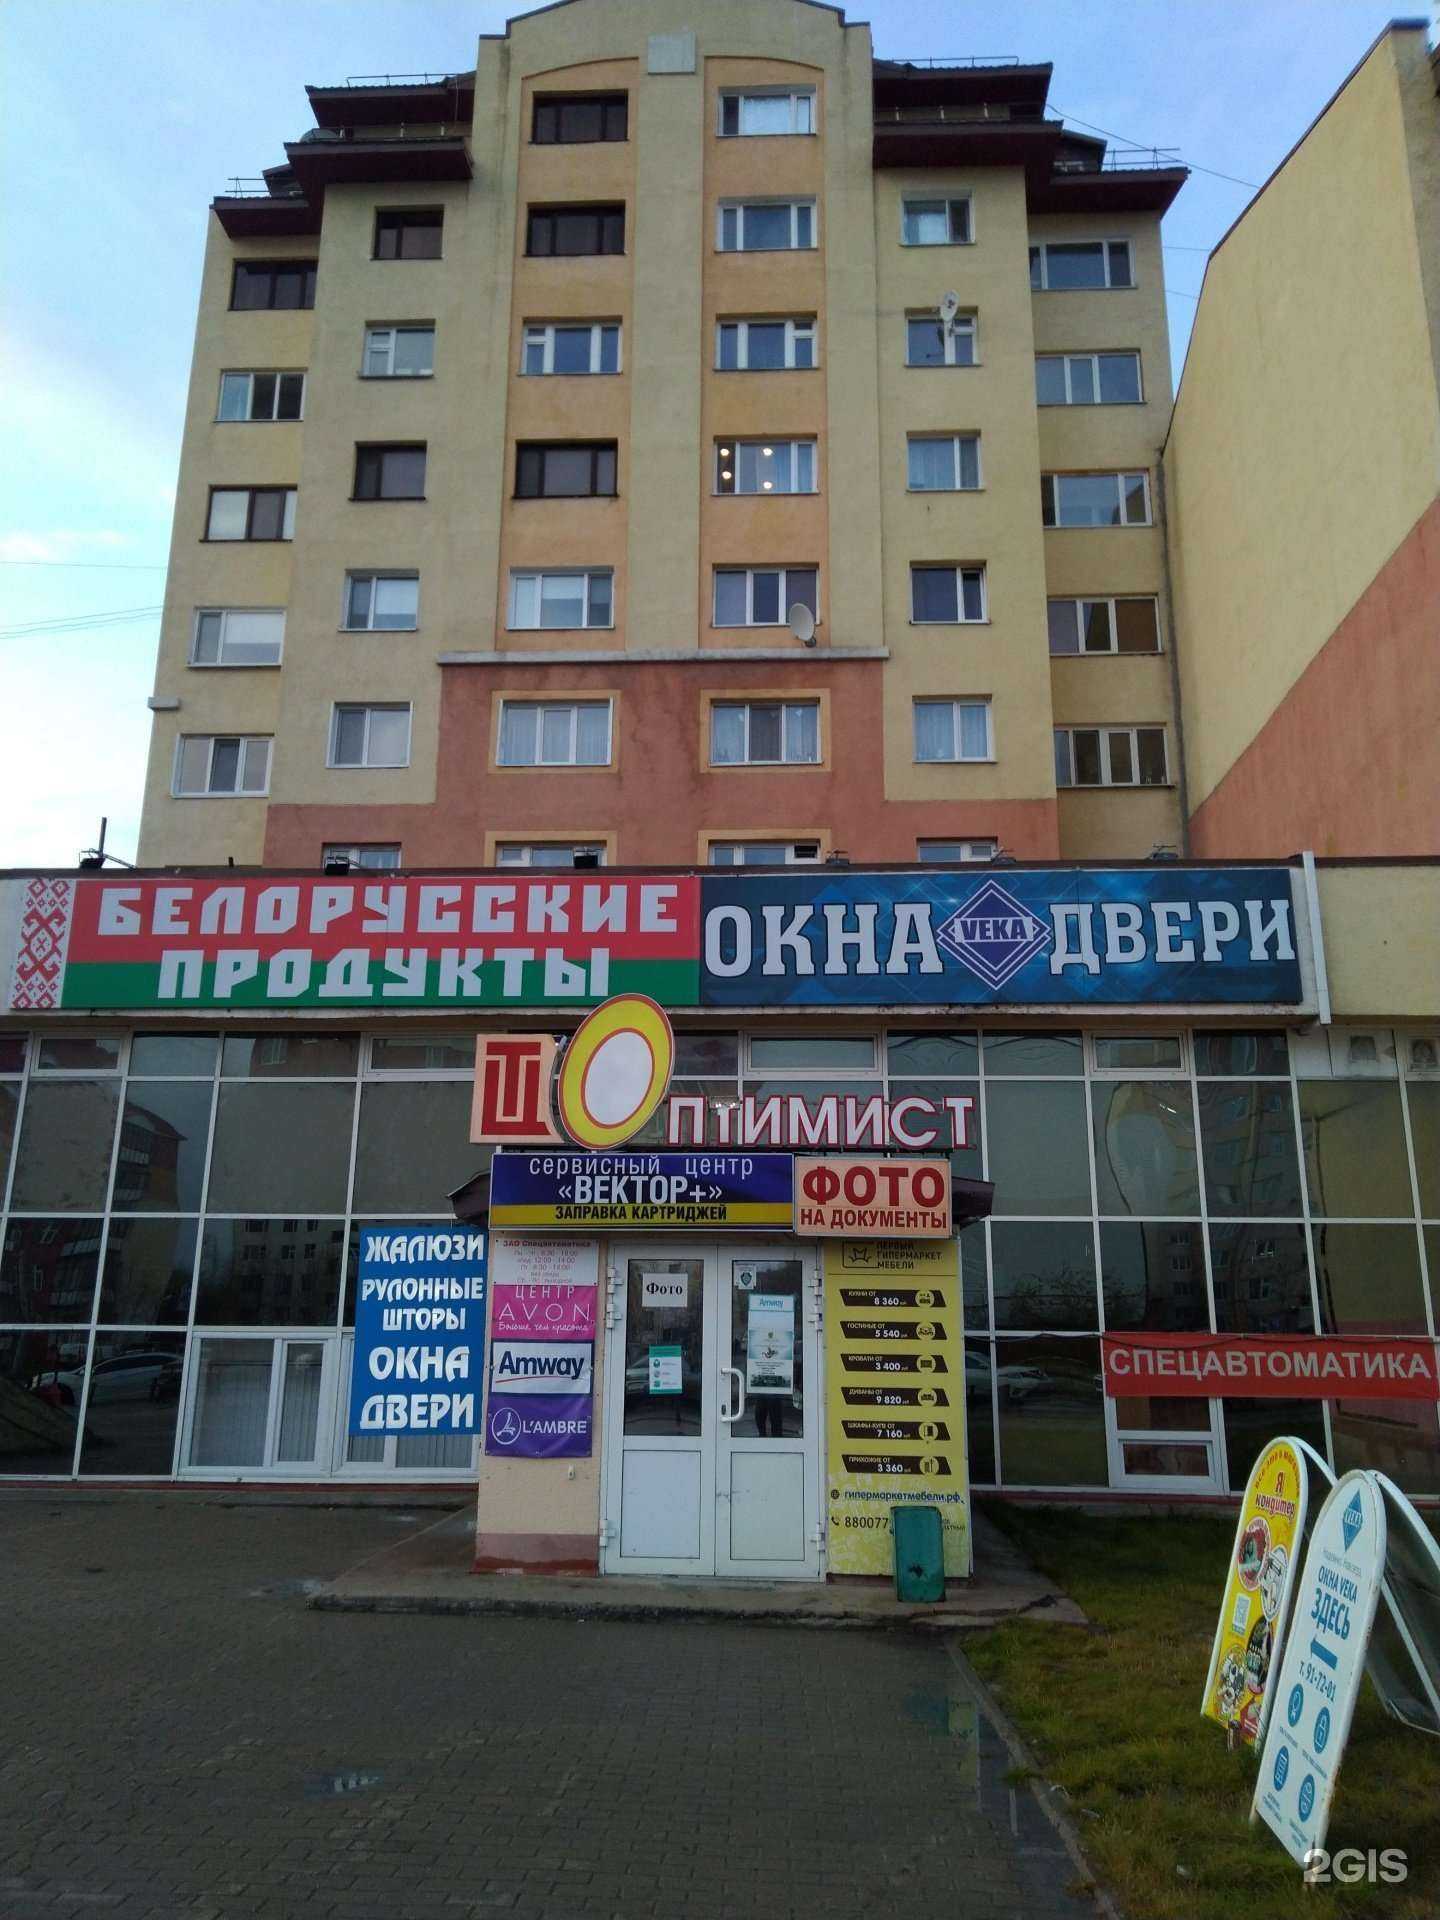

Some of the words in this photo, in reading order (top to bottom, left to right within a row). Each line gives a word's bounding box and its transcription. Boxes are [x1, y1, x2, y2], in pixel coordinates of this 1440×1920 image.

[98, 885, 678, 935] БЕЛОРУССКИЕ
[704, 903, 944, 977] ОКНА
[960, 918, 1028, 941] VEKA
[1049, 899, 1296, 976] ДВЕРИ
[157, 947, 610, 999] ПРОДУКТЫ
[529, 1157, 661, 1179] сервисный
[686, 1159, 754, 1179] центр
[558, 1175, 723, 1205] «ВЕКТОР+»
[802, 1165, 946, 1208] ФОТО
[555, 1204, 628, 1221] ЗАПРАВКА
[631, 1203, 728, 1222] КАРТРИДЖЕЙ
[800, 1208, 829, 1228] НА
[831, 1208, 948, 1230] ДОКУМЕНТЫ
[364, 1234, 485, 1264] ЖАЛЮЗИ
[876, 1251, 942, 1260] ГИПЕРМАРКЕТ
[877, 1260, 914, 1269] МЕБЕЛИ
[362, 1277, 484, 1302] РУЛОННЫЕ
[515, 1285, 575, 1300] ЦЕНТР
[646, 1282, 683, 1295] Фото
[382, 1308, 466, 1331] ШТОРЫ
[499, 1303, 590, 1322] AVON
[369, 1346, 470, 1383] ОКНА
[499, 1351, 585, 1380] Amway
[1108, 1348, 1432, 1381] СПЕЦАВТОМАТИКА
[360, 1394, 475, 1430] ДВЕРИ
[522, 1420, 587, 1434] L'AMBRE
[1345, 1511, 1361, 1526] VEKA
[1318, 1565, 1338, 1592] ОКНА
[1339, 1576, 1358, 1604] VEKA
[1311, 1587, 1351, 1640] ЗДЕСЬ
